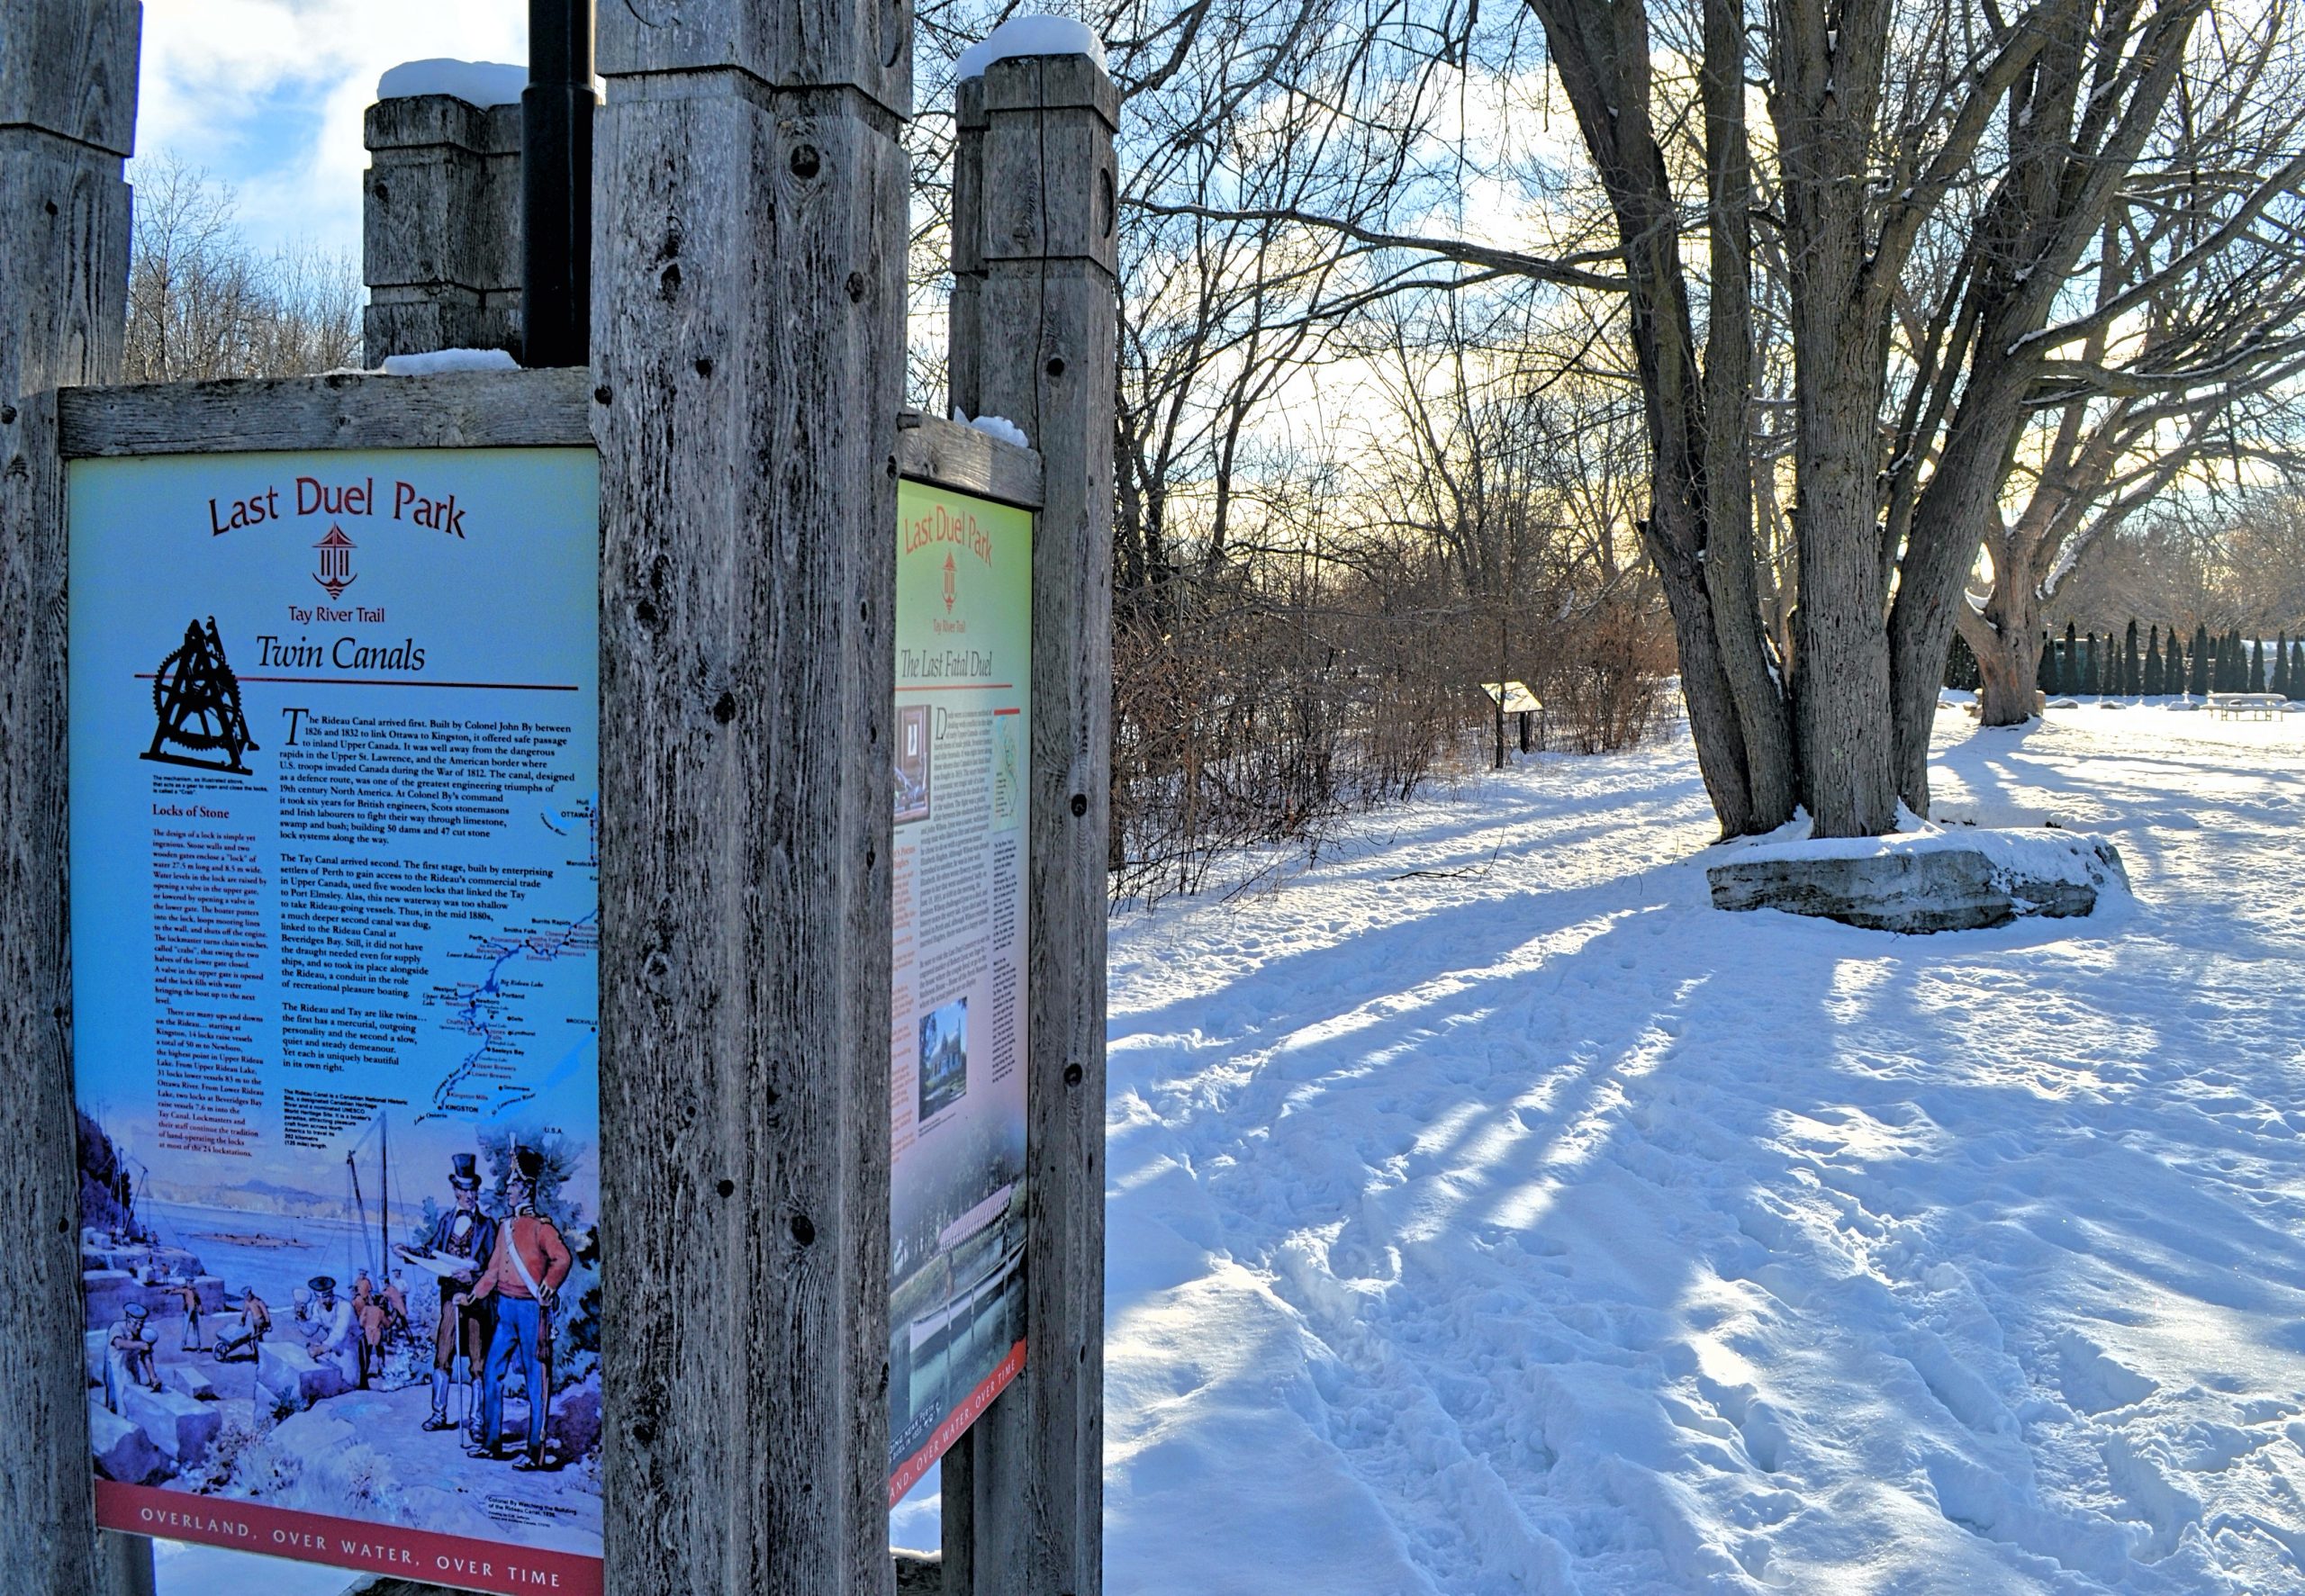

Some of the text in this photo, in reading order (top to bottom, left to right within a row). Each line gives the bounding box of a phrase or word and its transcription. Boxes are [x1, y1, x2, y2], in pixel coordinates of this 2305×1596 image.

[209, 477, 466, 539] Last Duel Park
[905, 505, 992, 568] Last Duel Park
[289, 606, 384, 625] Tay River Trail
[257, 636, 425, 671] Twin Canals
[901, 648, 992, 677] The Last Fatal Duel
[322, 716, 350, 725] Rideau
[353, 717, 375, 726] Canal
[378, 718, 406, 726] arrived
[409, 718, 427, 727] first.
[430, 719, 449, 728] Built
[453, 720, 462, 731] by
[465, 720, 497, 730] Colonel
[499, 722, 519, 733] John
[522, 722, 532, 734] By
[536, 723, 571, 732] between
[306, 726, 322, 735] 1826
[324, 727, 339, 736] and
[342, 728, 358, 736] 1832
[371, 729, 386, 737] link
[389, 729, 419, 739] Ottawa
[432, 731, 472, 743] Kingston,
[474, 733, 480, 741] it
[483, 733, 511, 742] offered
[514, 735, 531, 743] safe
[534, 737, 567, 746] passage
[303, 739, 311, 747] to
[313, 739, 338, 748] inland
[340, 740, 366, 751] Upper
[368, 741, 401, 750] Canada.
[404, 742, 411, 751] It
[430, 744, 447, 752] well
[450, 746, 469, 755] away
[473, 744, 493, 753] from
[495, 745, 508, 753] the
[511, 746, 555, 757] dangerous
[280, 750, 547, 768] rapids in the Upper St. Lawrence, and the American border where
[153, 803, 229, 818] Locks of Stone
[281, 853, 554, 877] The Tay Canal arrived second. The first stage, built by enterprising
[283, 1002, 298, 1011] The
[301, 1004, 329, 1014] Rideau
[331, 1006, 345, 1014] and
[348, 1007, 362, 1019] Tay
[379, 1009, 393, 1018] like
[283, 1014, 294, 1023] the
[297, 1014, 312, 1023] first
[315, 1016, 328, 1025] has
[338, 1019, 377, 1030] mercurial,
[380, 1023, 416, 1033] outgoing
[284, 1047, 399, 1065] Yet each is uniquely beautiful
[284, 1059, 291, 1068] in
[294, 1059, 303, 1069] its
[323, 1062, 344, 1073] right.
[917, 1440, 938, 1471] OVER
[976, 1381, 994, 1408] OVER
[998, 1359, 1015, 1384] TIME
[141, 1508, 559, 1587] OVERLAND, OVER WATER, OVER TIME
